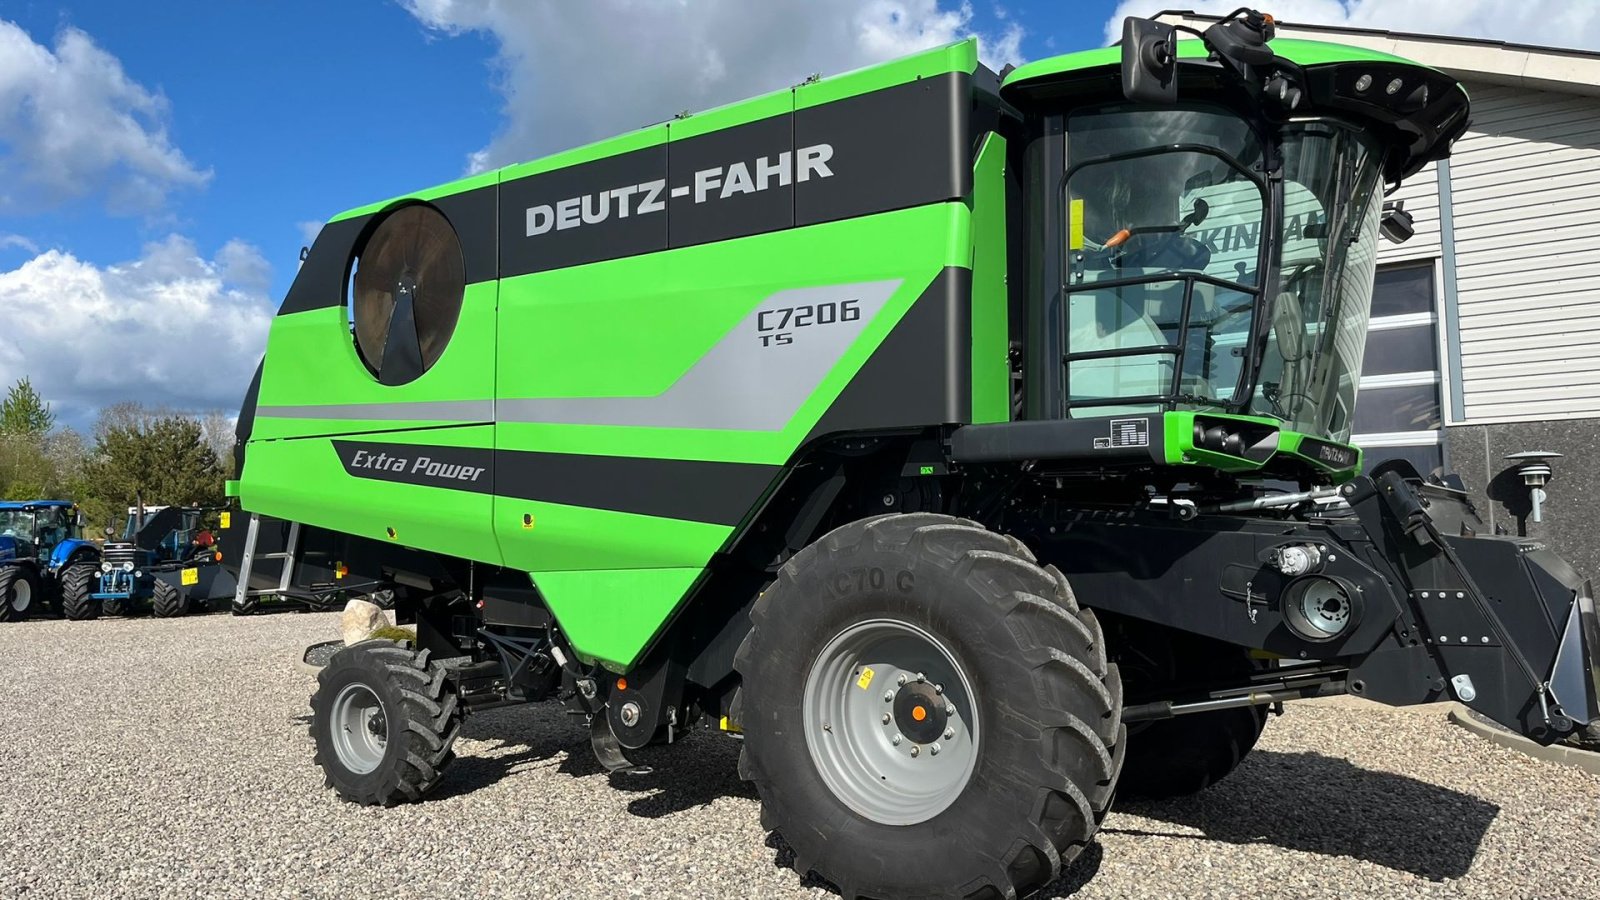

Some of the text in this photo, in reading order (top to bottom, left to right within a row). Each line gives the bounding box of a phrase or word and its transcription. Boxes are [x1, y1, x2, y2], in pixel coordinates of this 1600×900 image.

[526, 143, 834, 237] DEUTZ-FAHR
[758, 299, 859, 332] C7206
[758, 332, 793, 347] TS
[351, 450, 485, 481] Extra Power
